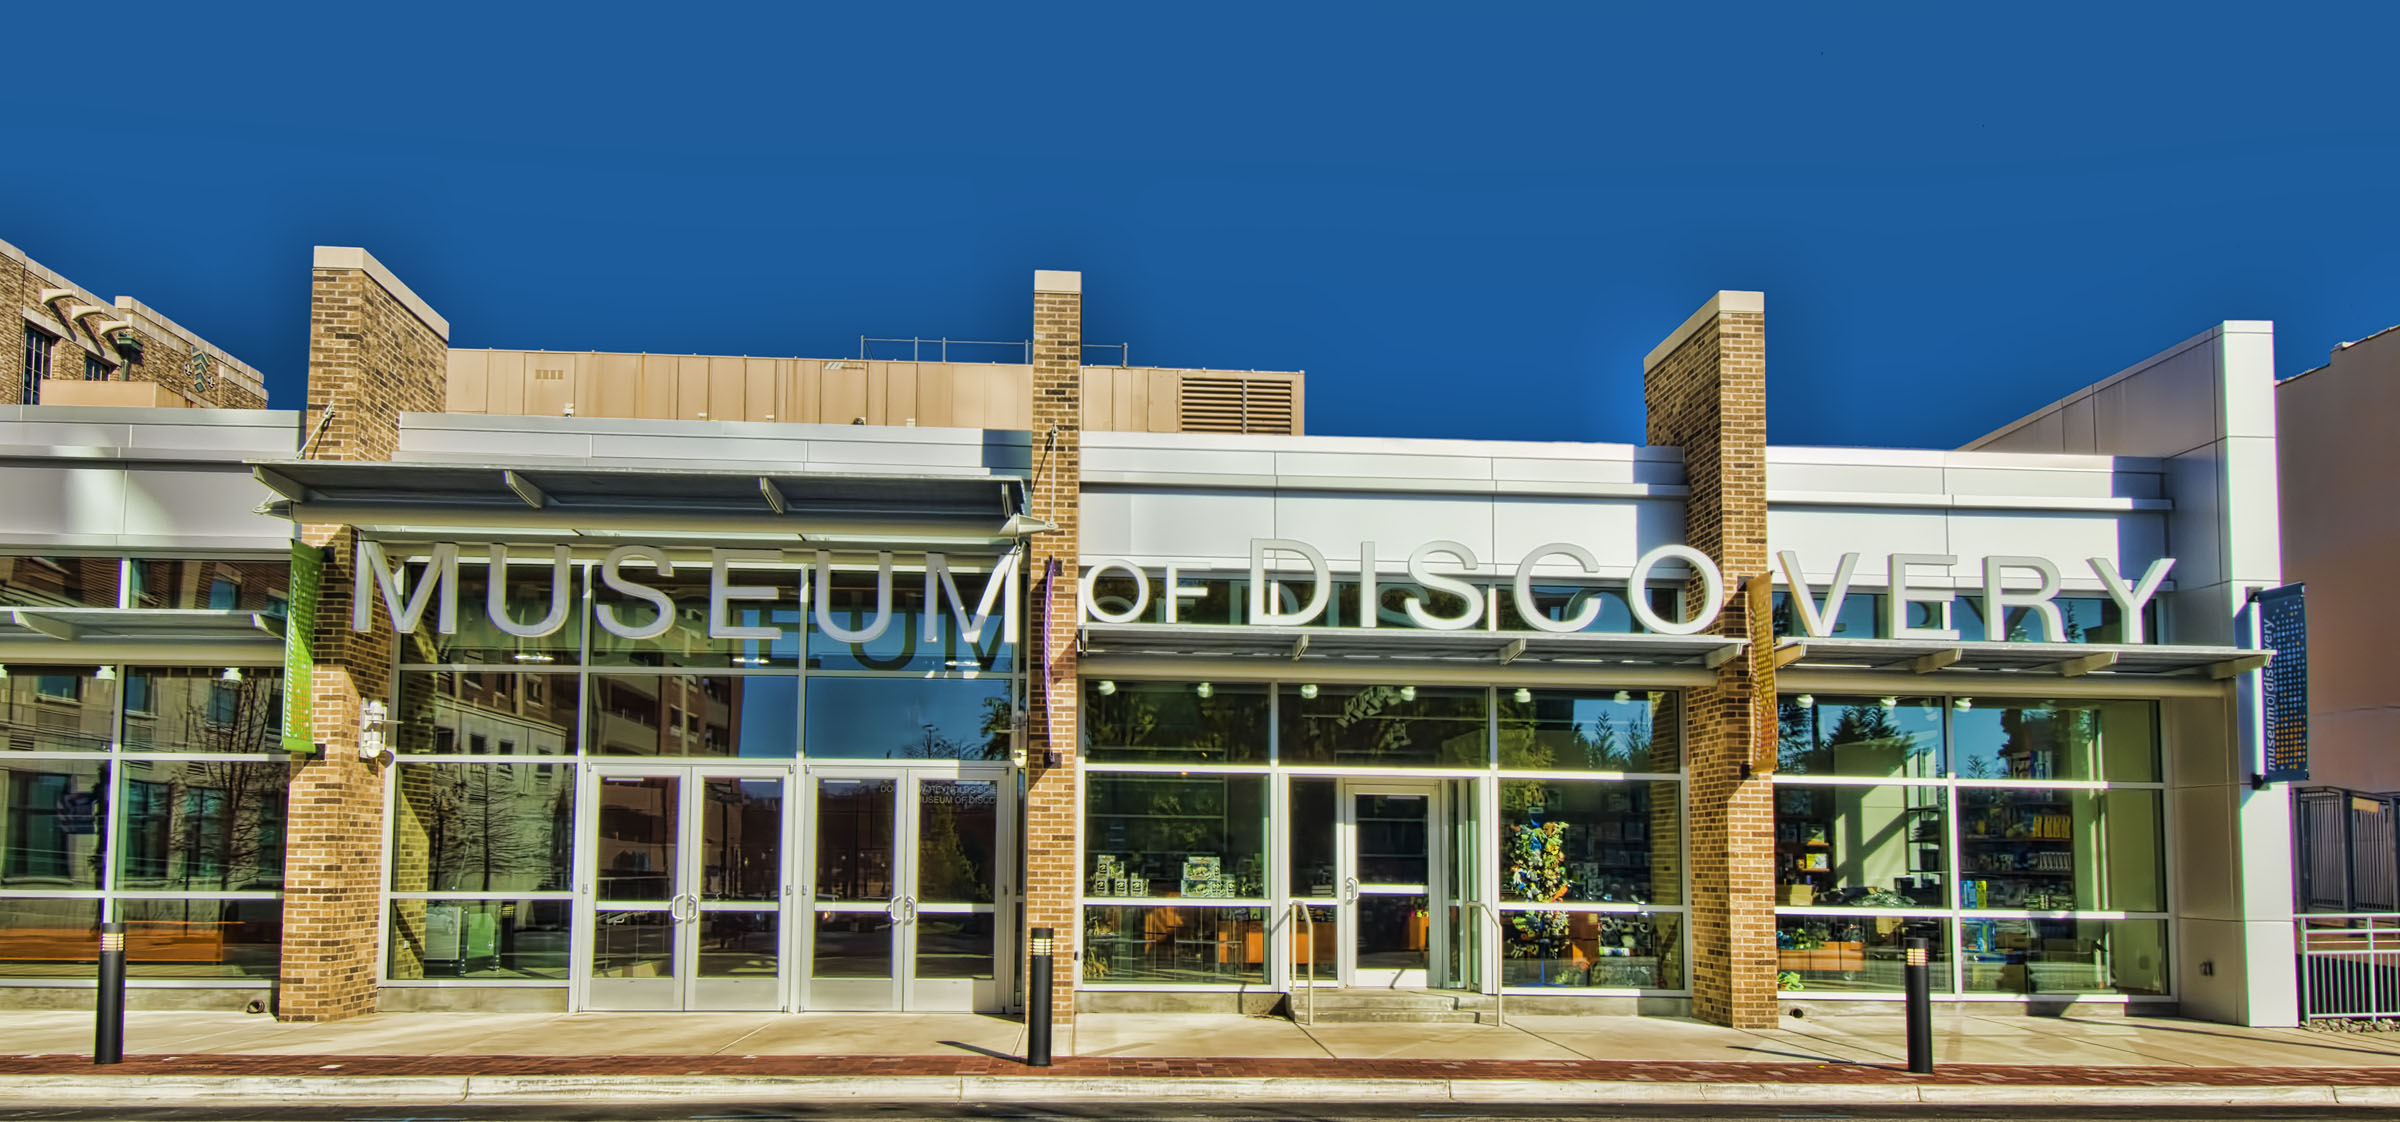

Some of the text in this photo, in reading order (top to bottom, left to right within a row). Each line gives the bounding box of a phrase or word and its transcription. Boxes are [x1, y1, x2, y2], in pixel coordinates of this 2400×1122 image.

[352, 532, 2177, 644] MUSEUM OF DISCOVERY
[2263, 618, 2276, 772] museumofdiscvery
